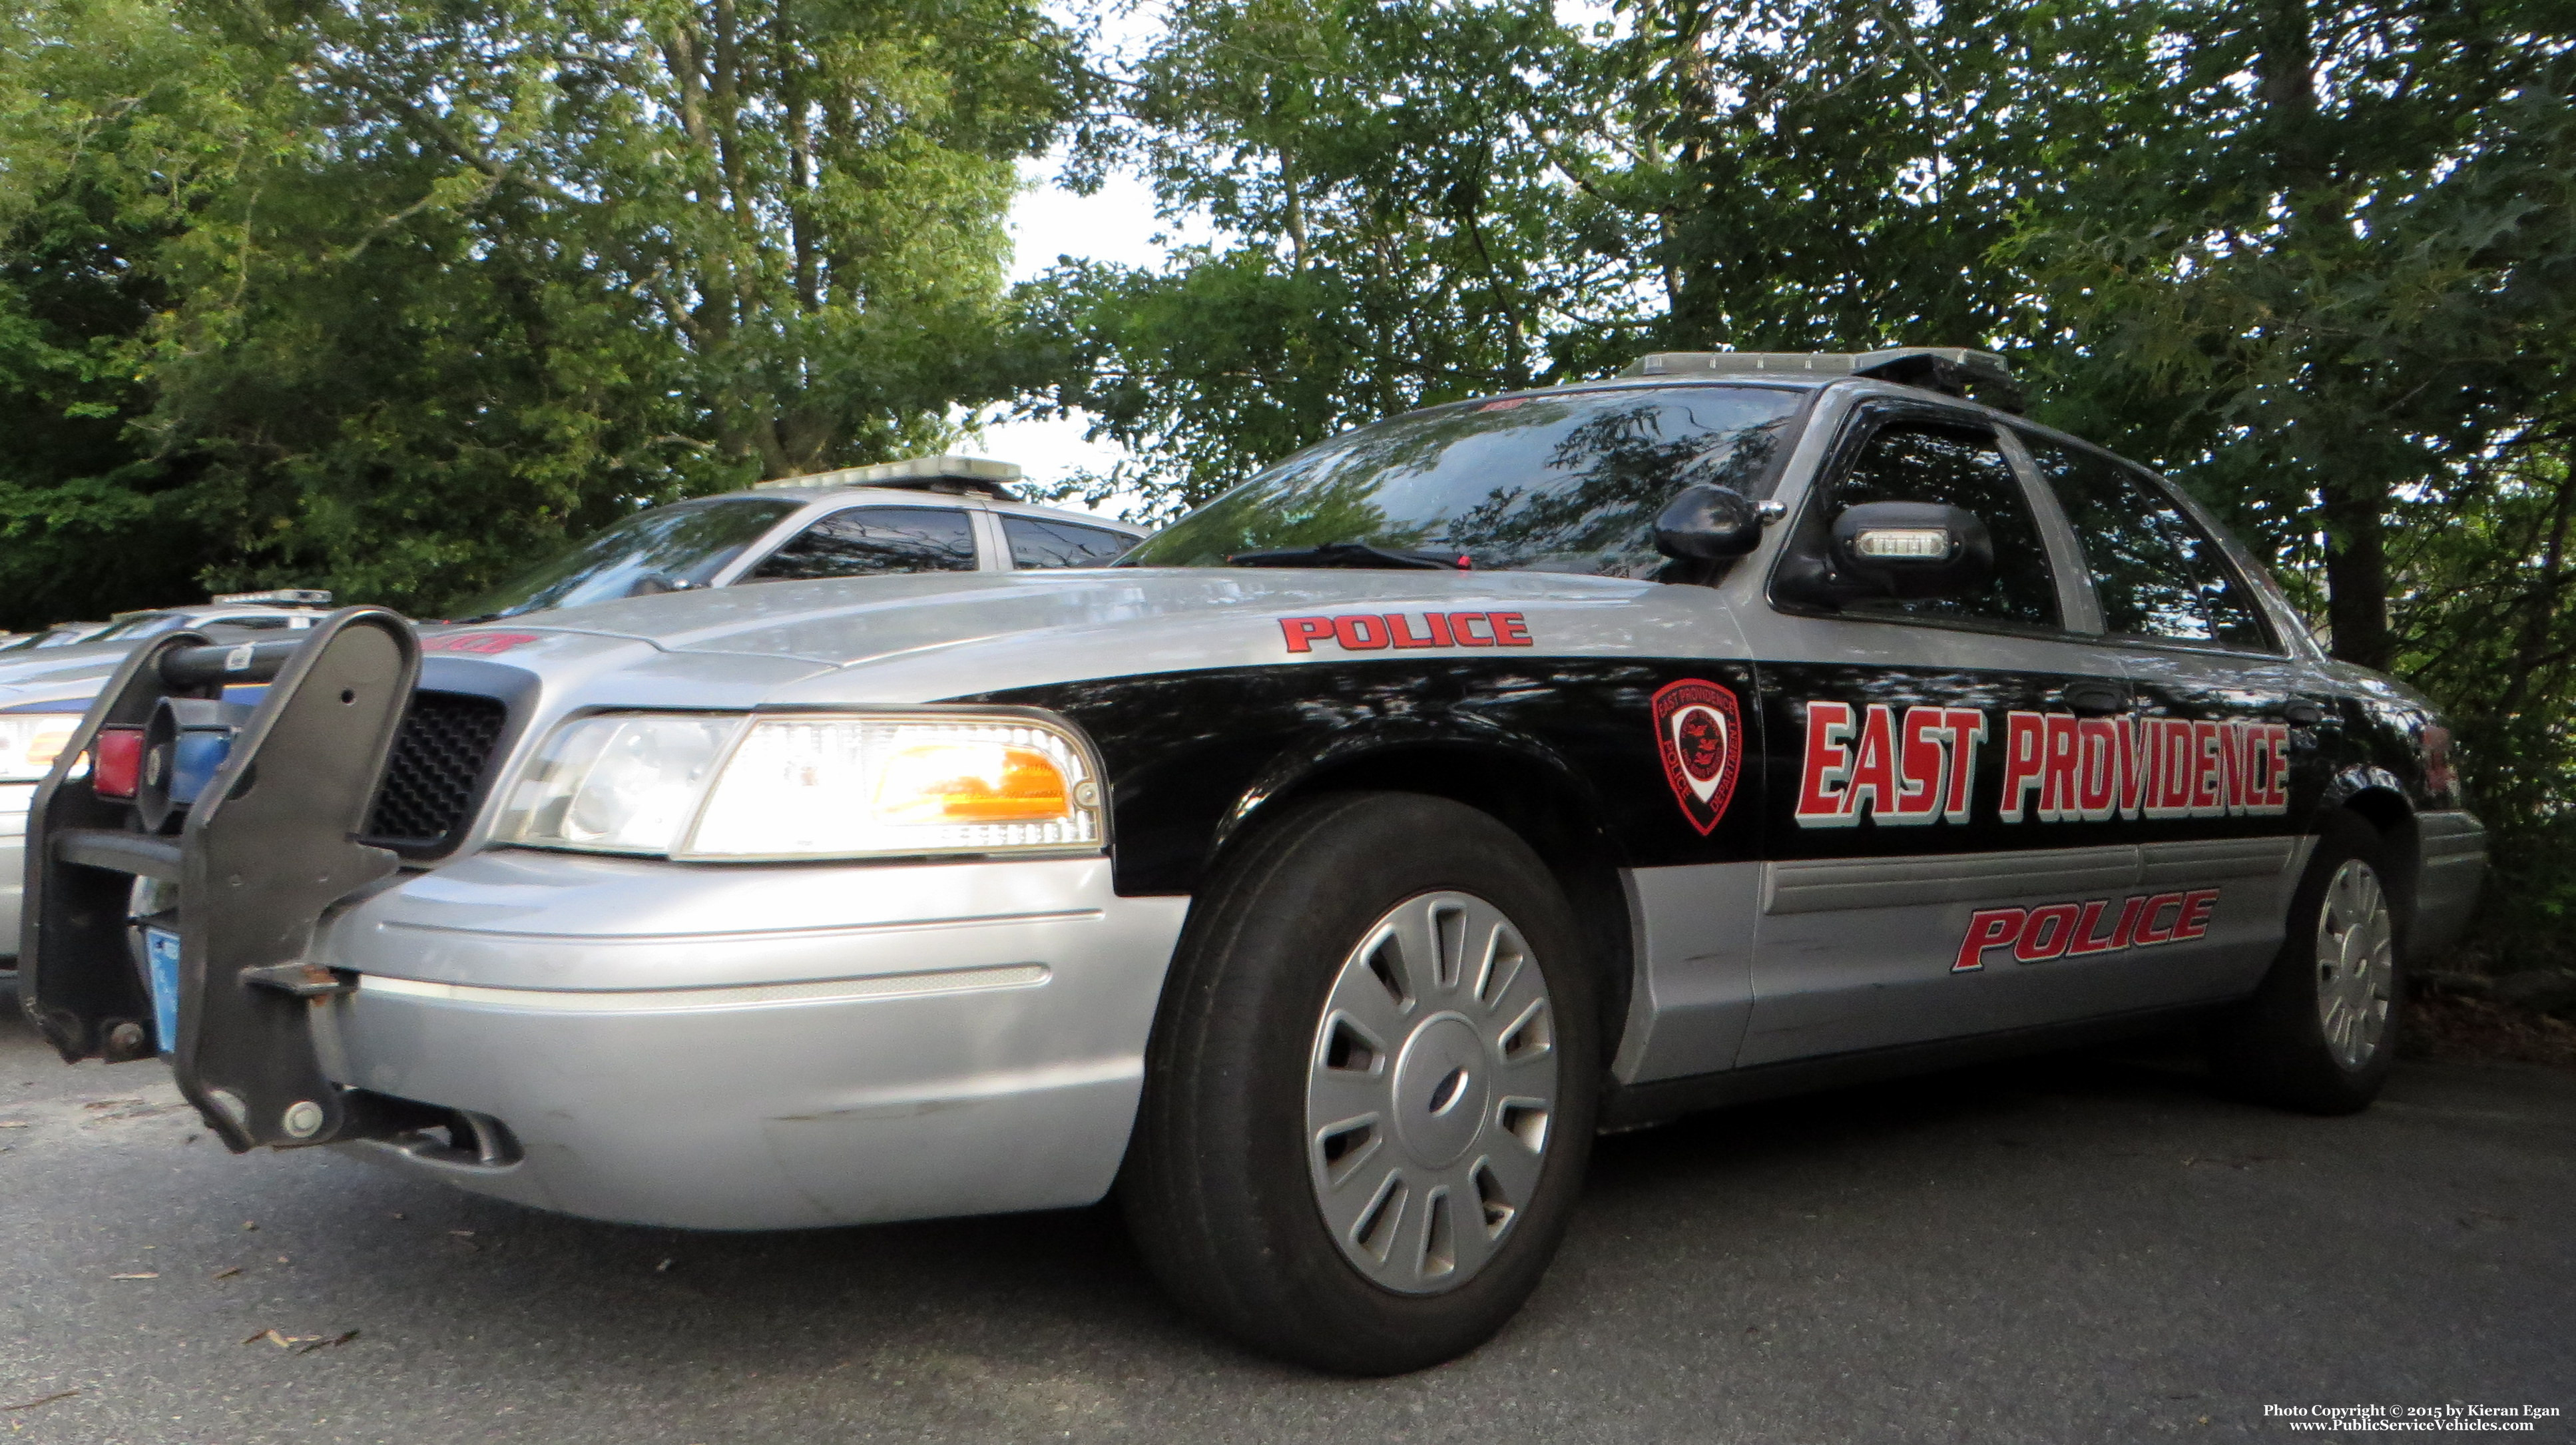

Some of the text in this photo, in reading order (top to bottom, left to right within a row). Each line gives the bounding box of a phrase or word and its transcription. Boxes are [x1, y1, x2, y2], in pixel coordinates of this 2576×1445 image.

[1278, 612, 1533, 653] POLICE
[1658, 687, 1735, 719] EAST PROVIDENCE
[1663, 738, 1693, 799] POLICE
[1710, 719, 1740, 812] DEPARTMENT
[1796, 701, 1987, 828] EAST
[1999, 710, 2290, 823] PROVIDENCE
[1949, 888, 2220, 973] POLICE
